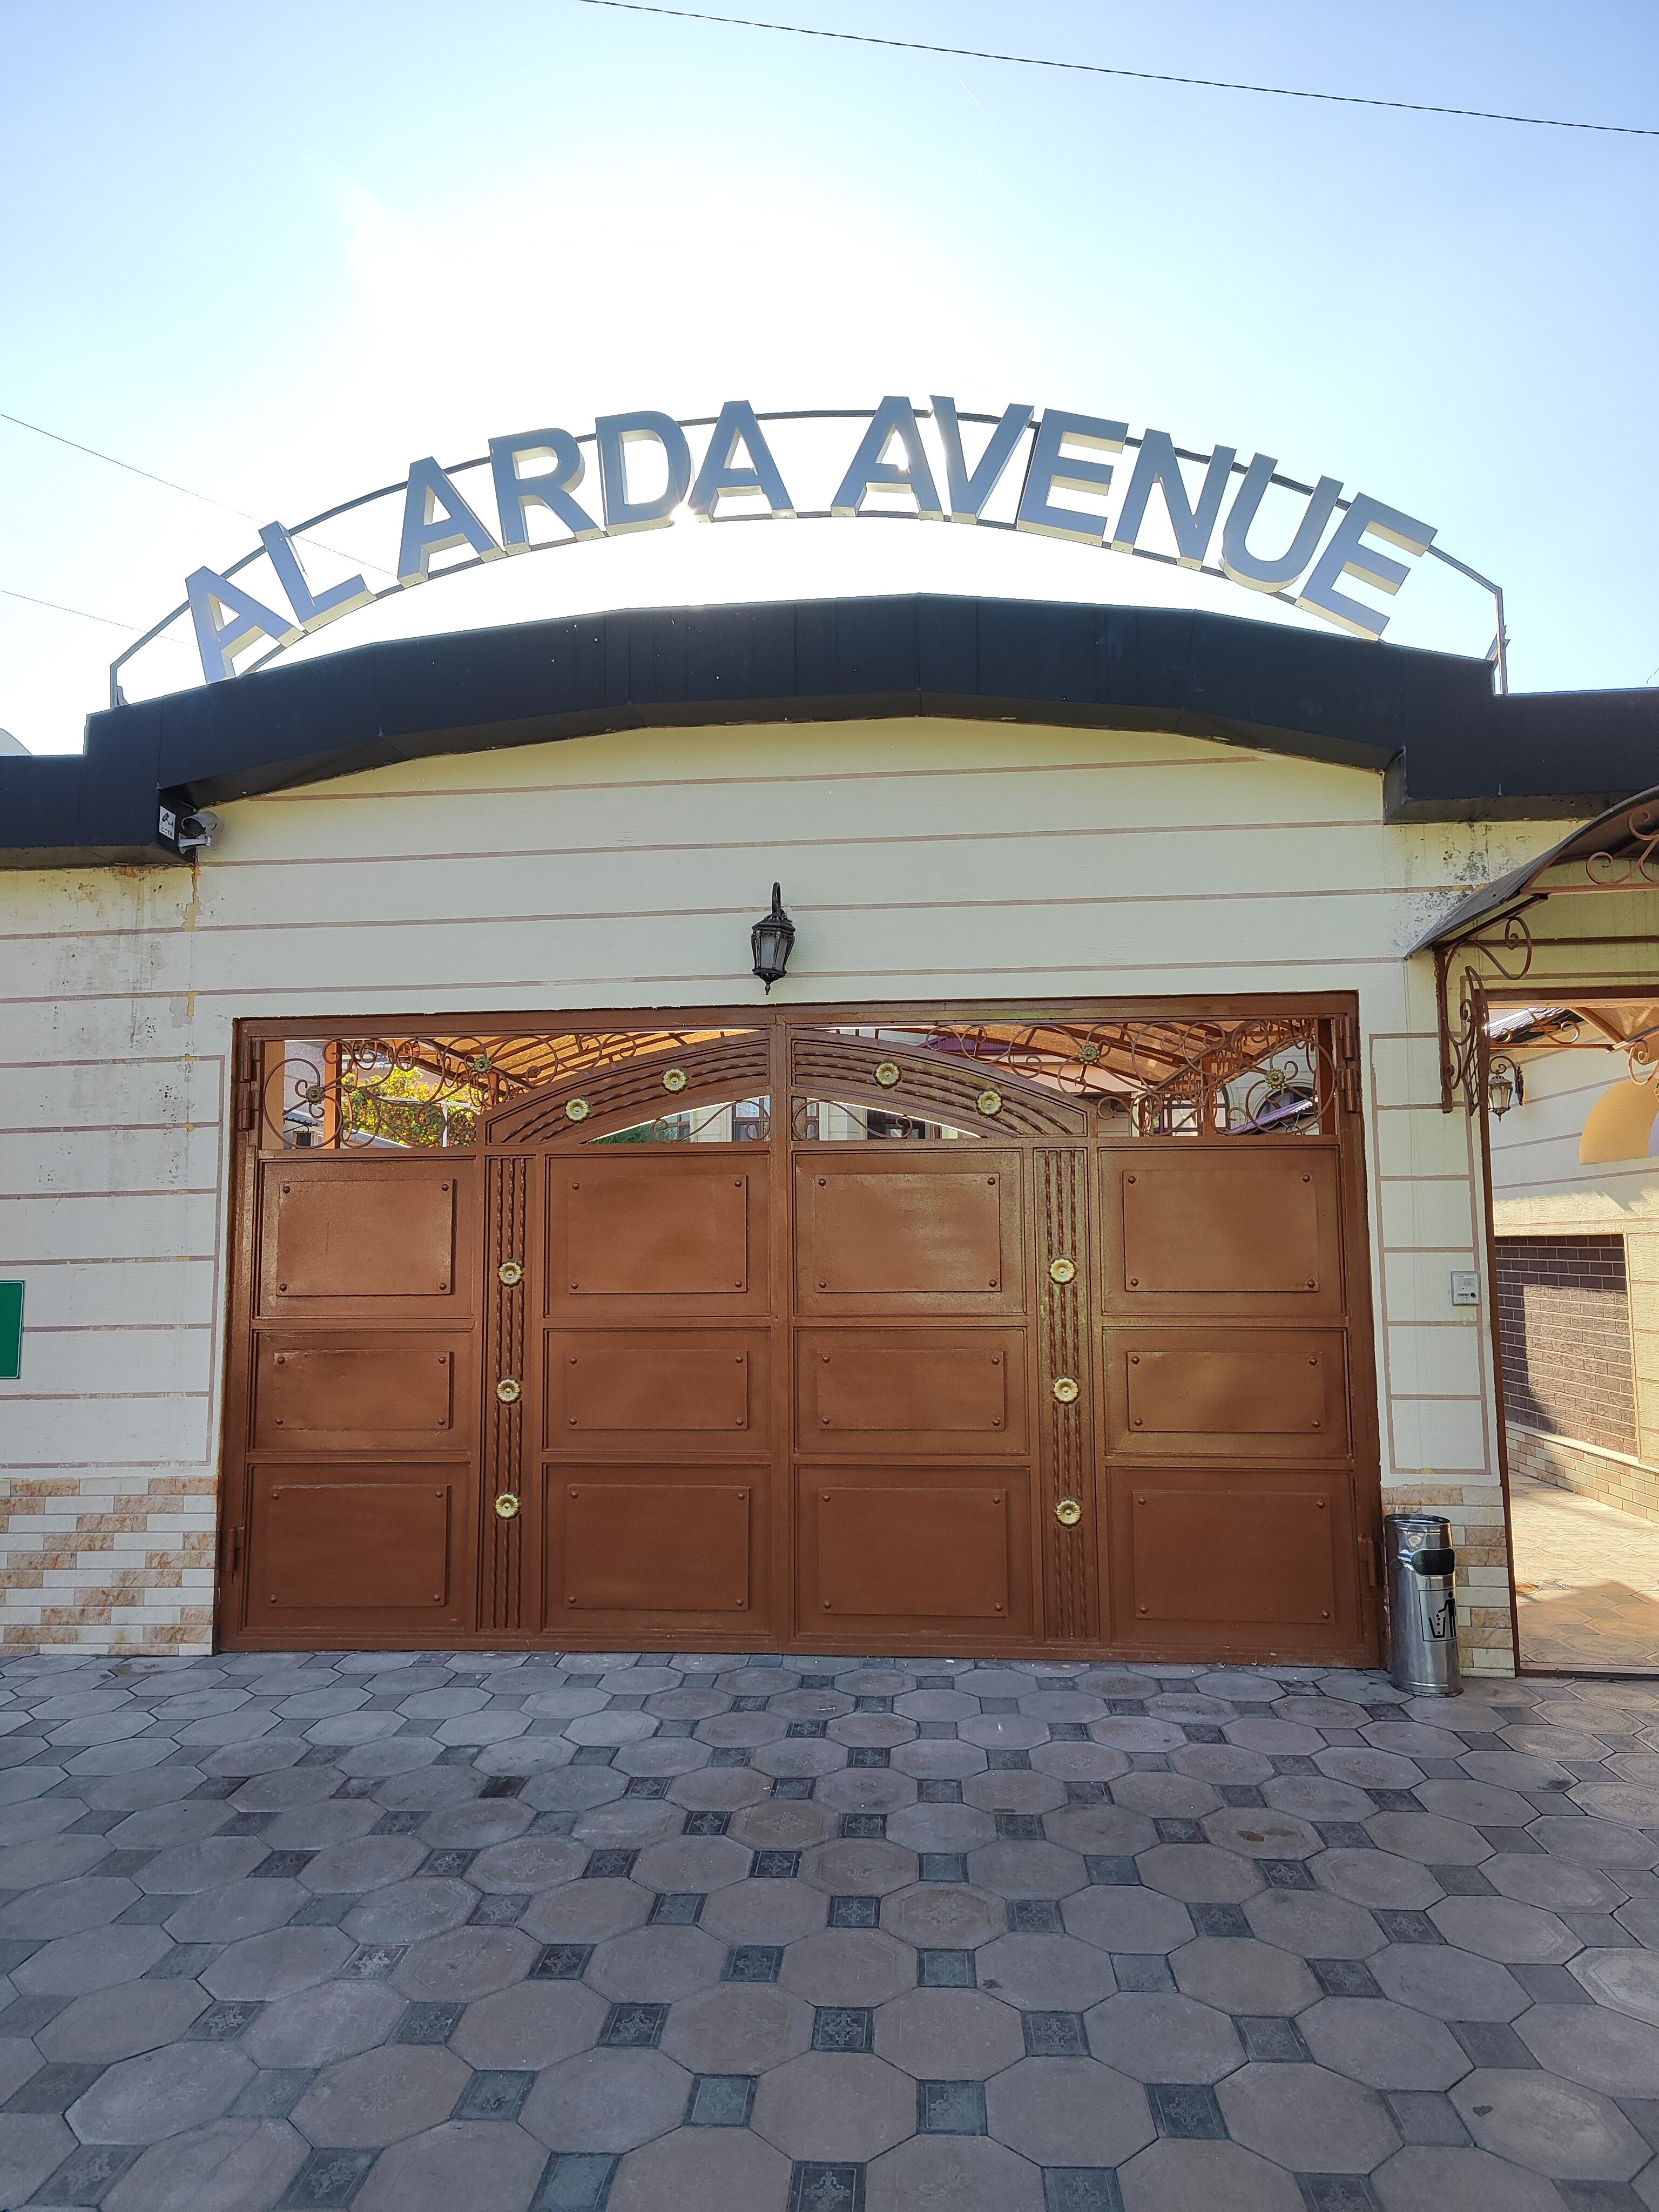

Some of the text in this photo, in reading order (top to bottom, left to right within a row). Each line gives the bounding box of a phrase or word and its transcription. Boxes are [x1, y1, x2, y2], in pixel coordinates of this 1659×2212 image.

[185, 395, 1438, 684] AL ARDA AVENUE
[161, 826, 173, 837] CCTV
